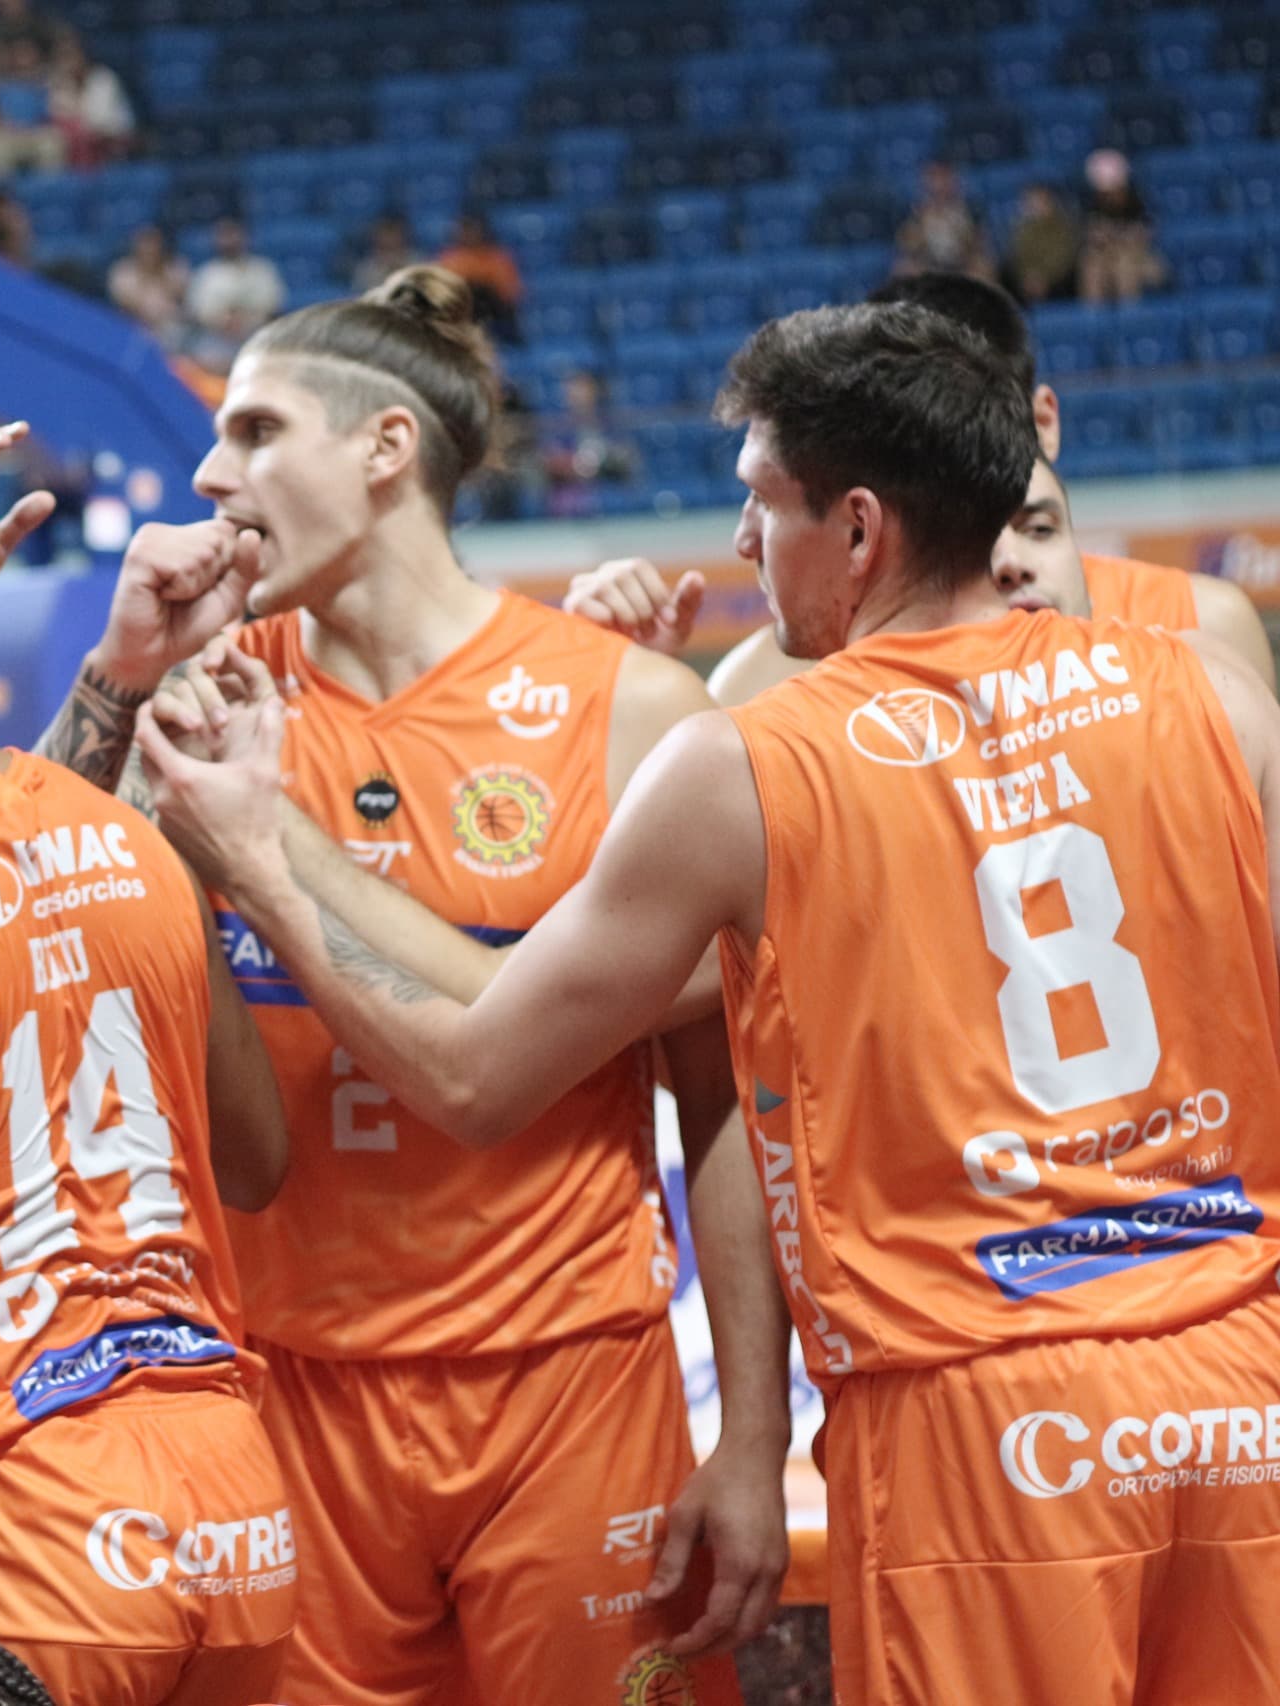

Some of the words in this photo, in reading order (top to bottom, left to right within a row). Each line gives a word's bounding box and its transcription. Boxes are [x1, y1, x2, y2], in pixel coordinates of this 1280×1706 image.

[973, 822, 1161, 1117] 8
[1044, 1087, 1230, 1173] raposo
[988, 1218, 1131, 1276] FARMA
[1131, 1190, 1253, 1235] CONDE
[20, 1336, 121, 1398] FARMA
